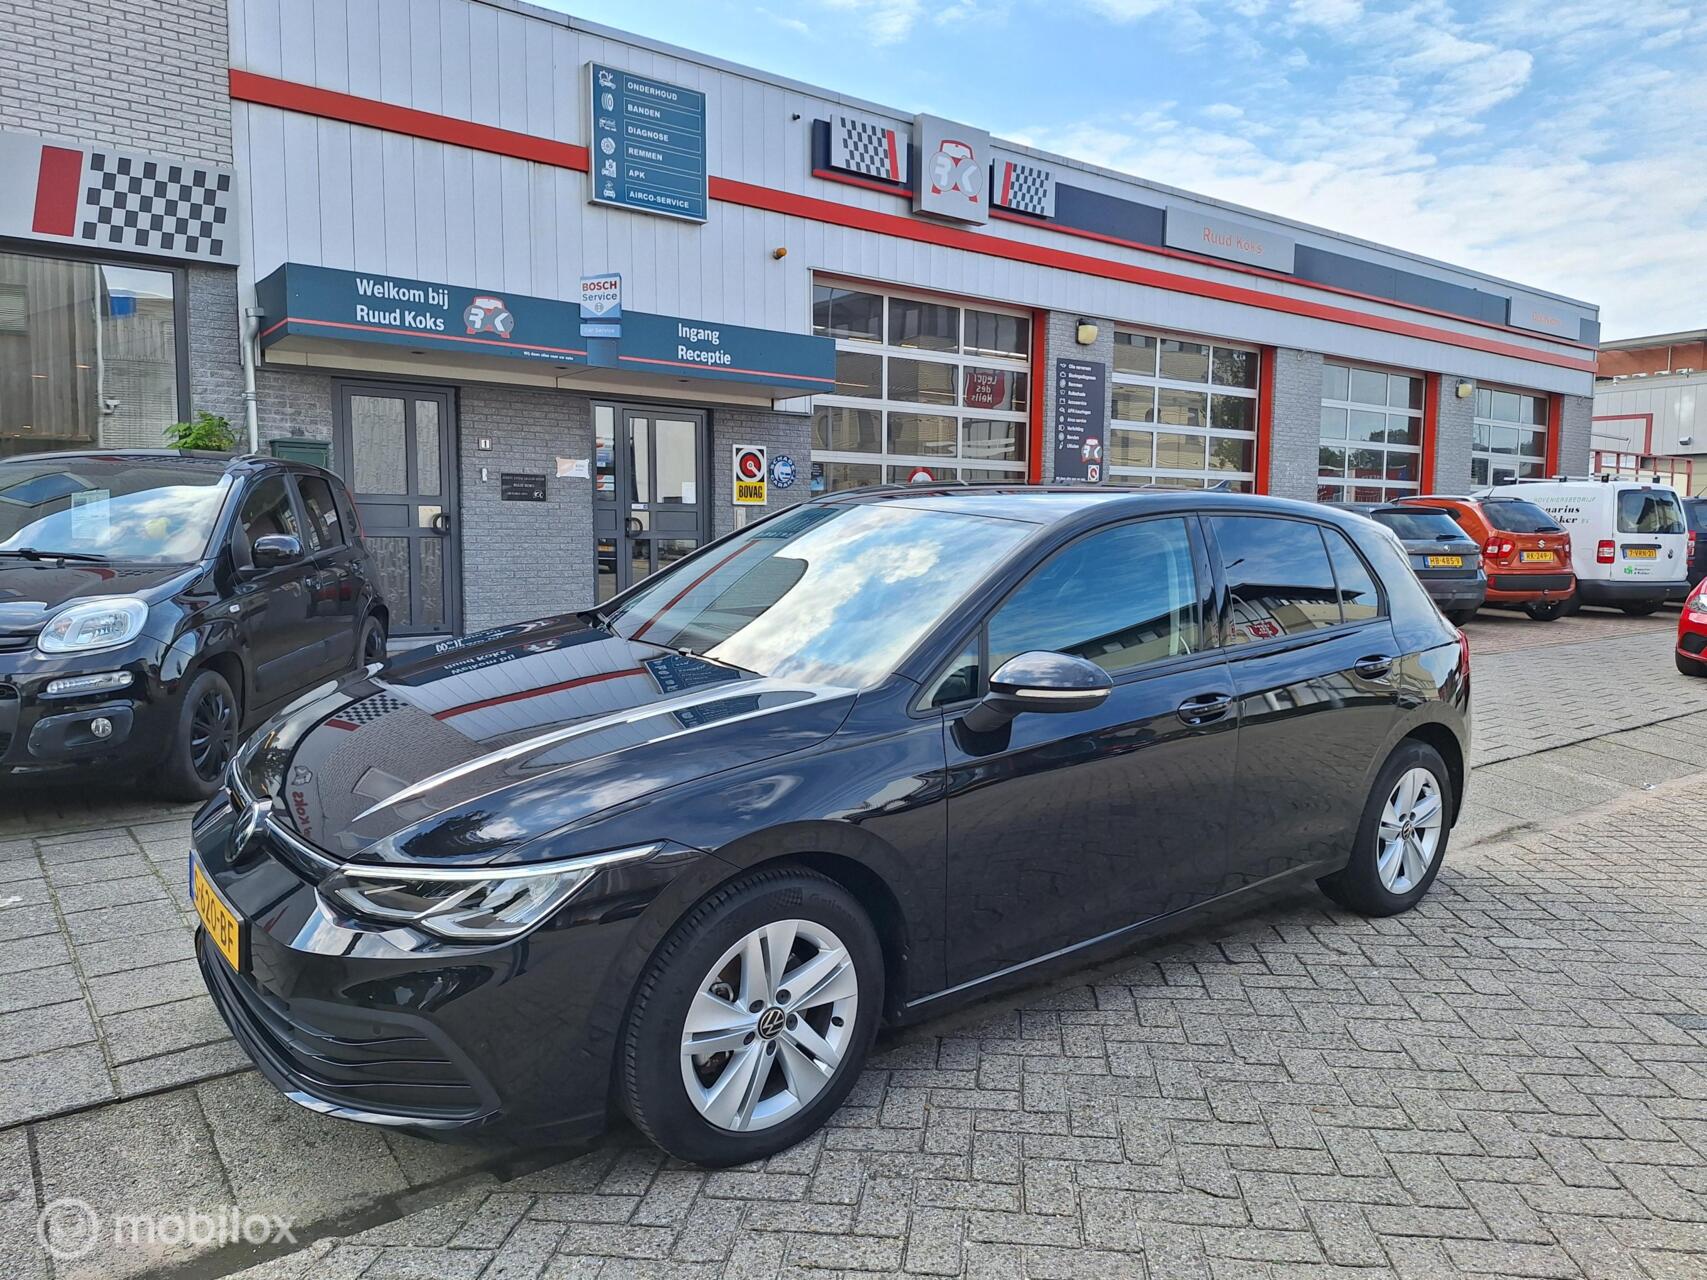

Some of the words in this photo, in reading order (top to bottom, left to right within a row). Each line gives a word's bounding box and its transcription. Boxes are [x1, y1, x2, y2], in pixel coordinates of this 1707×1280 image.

[627, 82, 678, 101] ONDERHOUD
[627, 104, 661, 118] BANDEN
[627, 126, 669, 142] DIAGNOSE
[628, 147, 663, 161] REMMEN
[629, 170, 646, 179] APK
[629, 190, 690, 209] AIRCO-SERVICE
[1203, 227, 1232, 247] Ruud
[1236, 238, 1264, 255] Koks
[356, 278, 424, 303] Welkom
[428, 287, 449, 309] bij
[582, 280, 617, 292] BOSCH
[582, 292, 617, 301] Service
[356, 305, 400, 326] Ruud
[404, 310, 445, 331] Koks
[678, 323, 720, 345] Ingang
[678, 345, 731, 366] Receptie
[738, 485, 763, 499] BOVAG
[194, 869, 234, 954] S-620-BF
